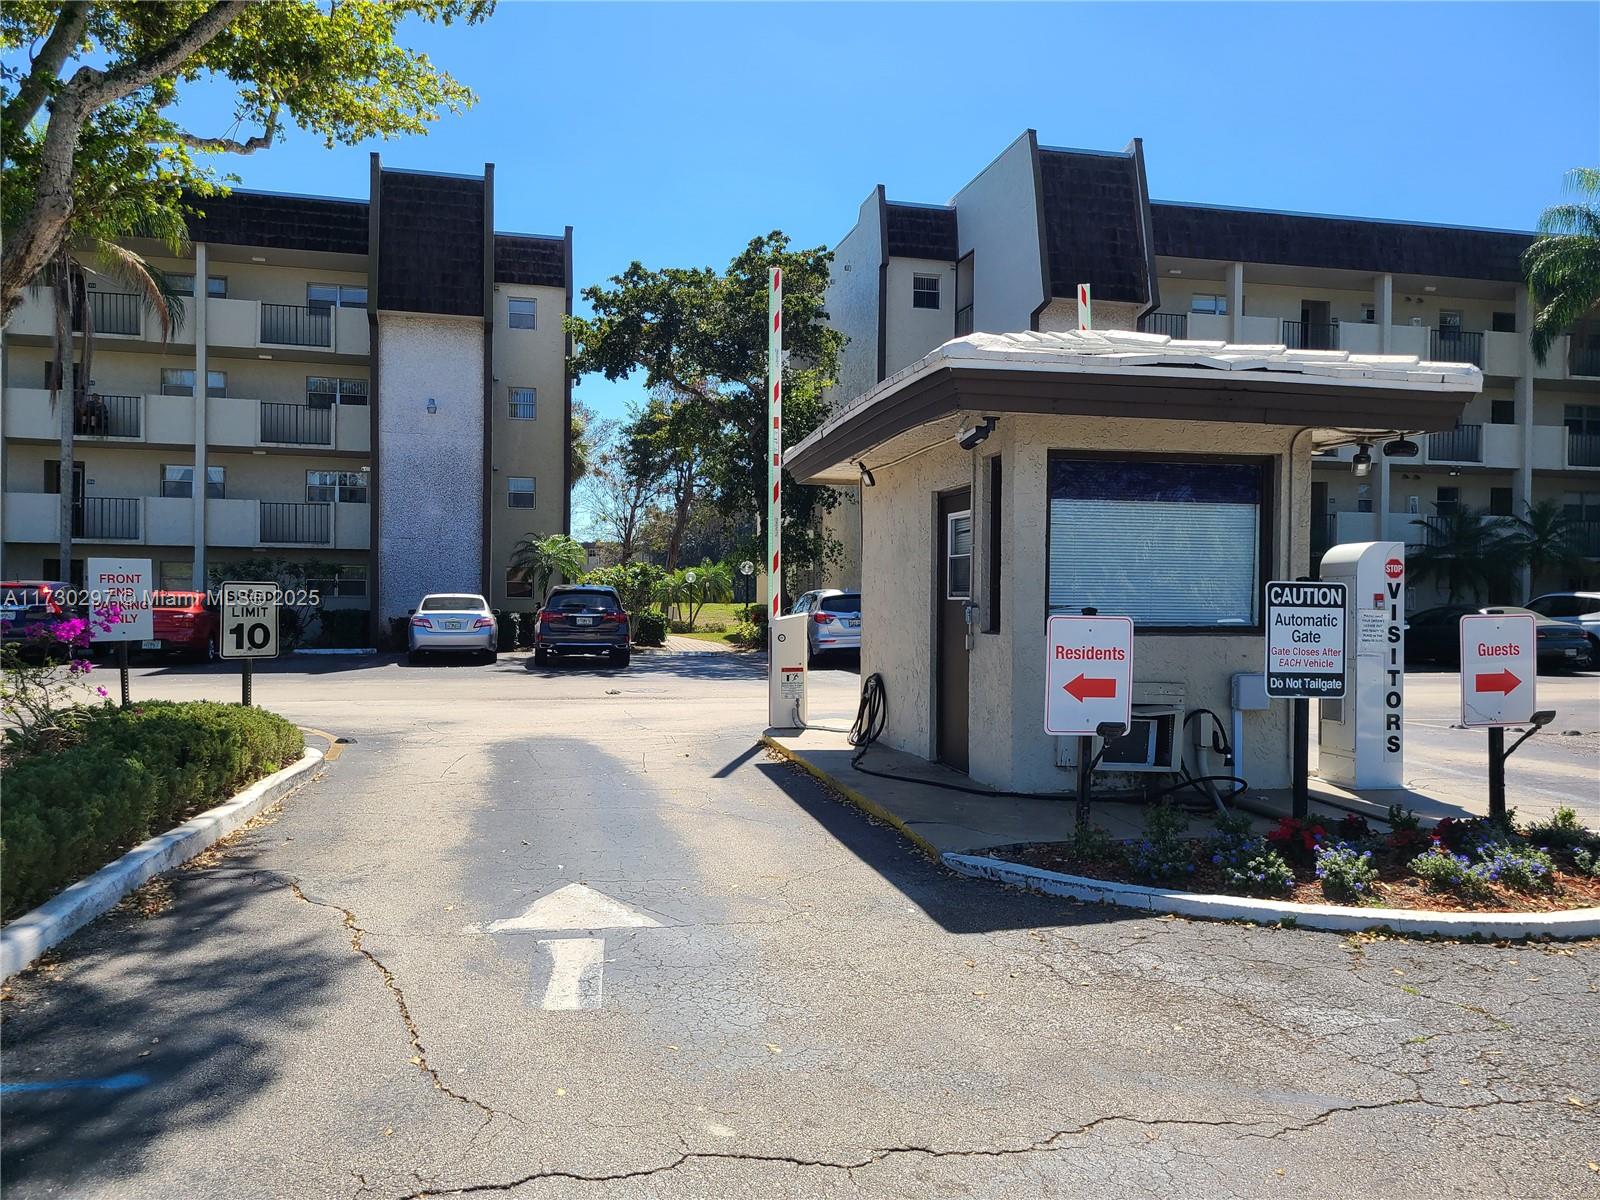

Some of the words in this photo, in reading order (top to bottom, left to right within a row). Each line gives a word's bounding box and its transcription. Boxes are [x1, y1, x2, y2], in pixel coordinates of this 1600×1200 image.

[1385, 564, 1403, 573] STOP
[99, 574, 142, 584] FRONT
[108, 587, 134, 597] END
[1270, 587, 1342, 605] CAUTION
[93, 600, 149, 610] PARKING
[108, 613, 138, 624] NLY
[232, 607, 269, 618] LIMIT
[1275, 612, 1338, 627] Automatic
[229, 622, 271, 650] 10
[1291, 629, 1321, 643] Gate
[1055, 645, 1126, 661] Residents
[1271, 646, 1290, 656] Gate
[1292, 647, 1320, 657] Closes
[1322, 647, 1342, 657] After
[1478, 643, 1520, 657] Guests
[1278, 658, 1301, 667] EACH
[1303, 659, 1334, 668] Vehicle
[1386, 582, 1402, 753] VISITORS
[1270, 678, 1284, 689] Do
[1285, 678, 1302, 689] Not
[1304, 678, 1342, 692] Tailgate
